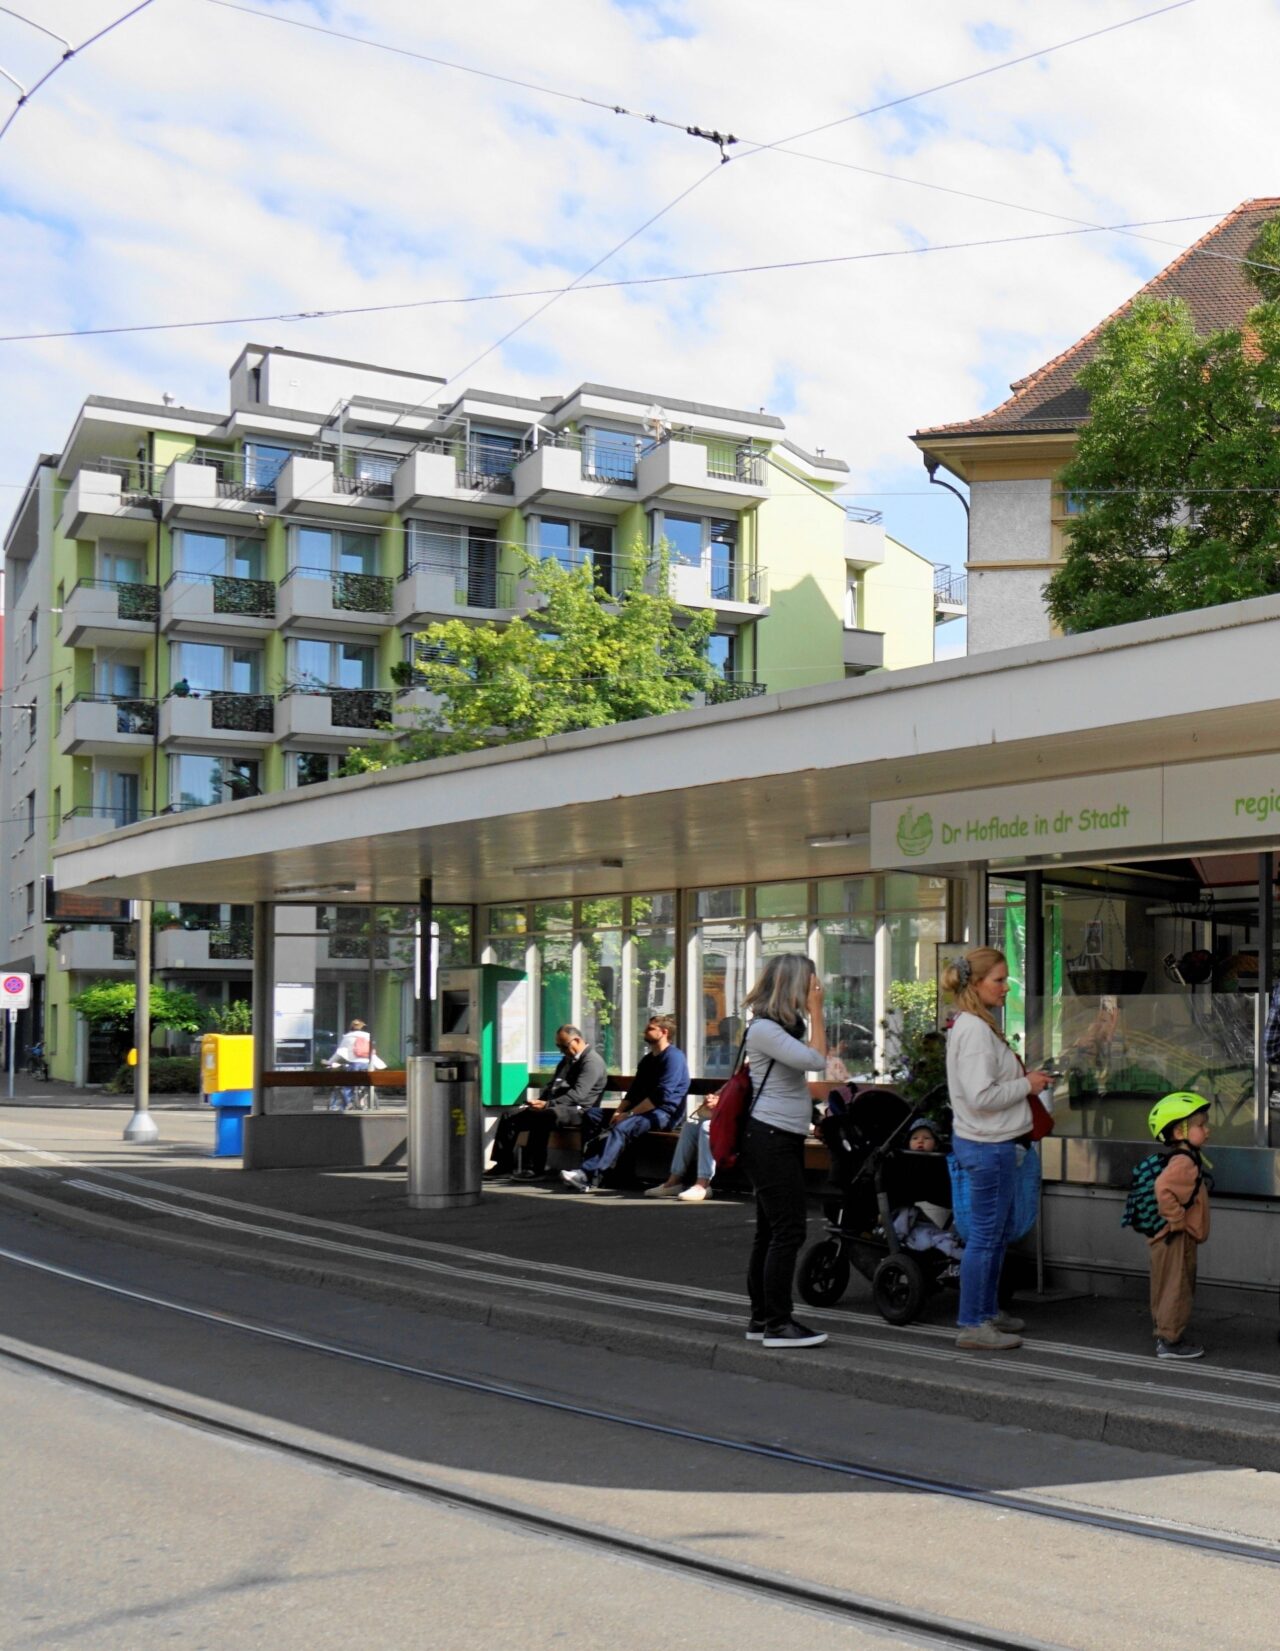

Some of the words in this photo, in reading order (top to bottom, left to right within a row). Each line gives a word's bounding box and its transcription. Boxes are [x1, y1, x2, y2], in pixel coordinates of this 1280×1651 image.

[941, 823, 962, 845] Dr
[966, 815, 1029, 842] Hoflade
[1034, 814, 1049, 835] in
[1053, 810, 1073, 834] dr
[1078, 804, 1130, 832] Stadt
